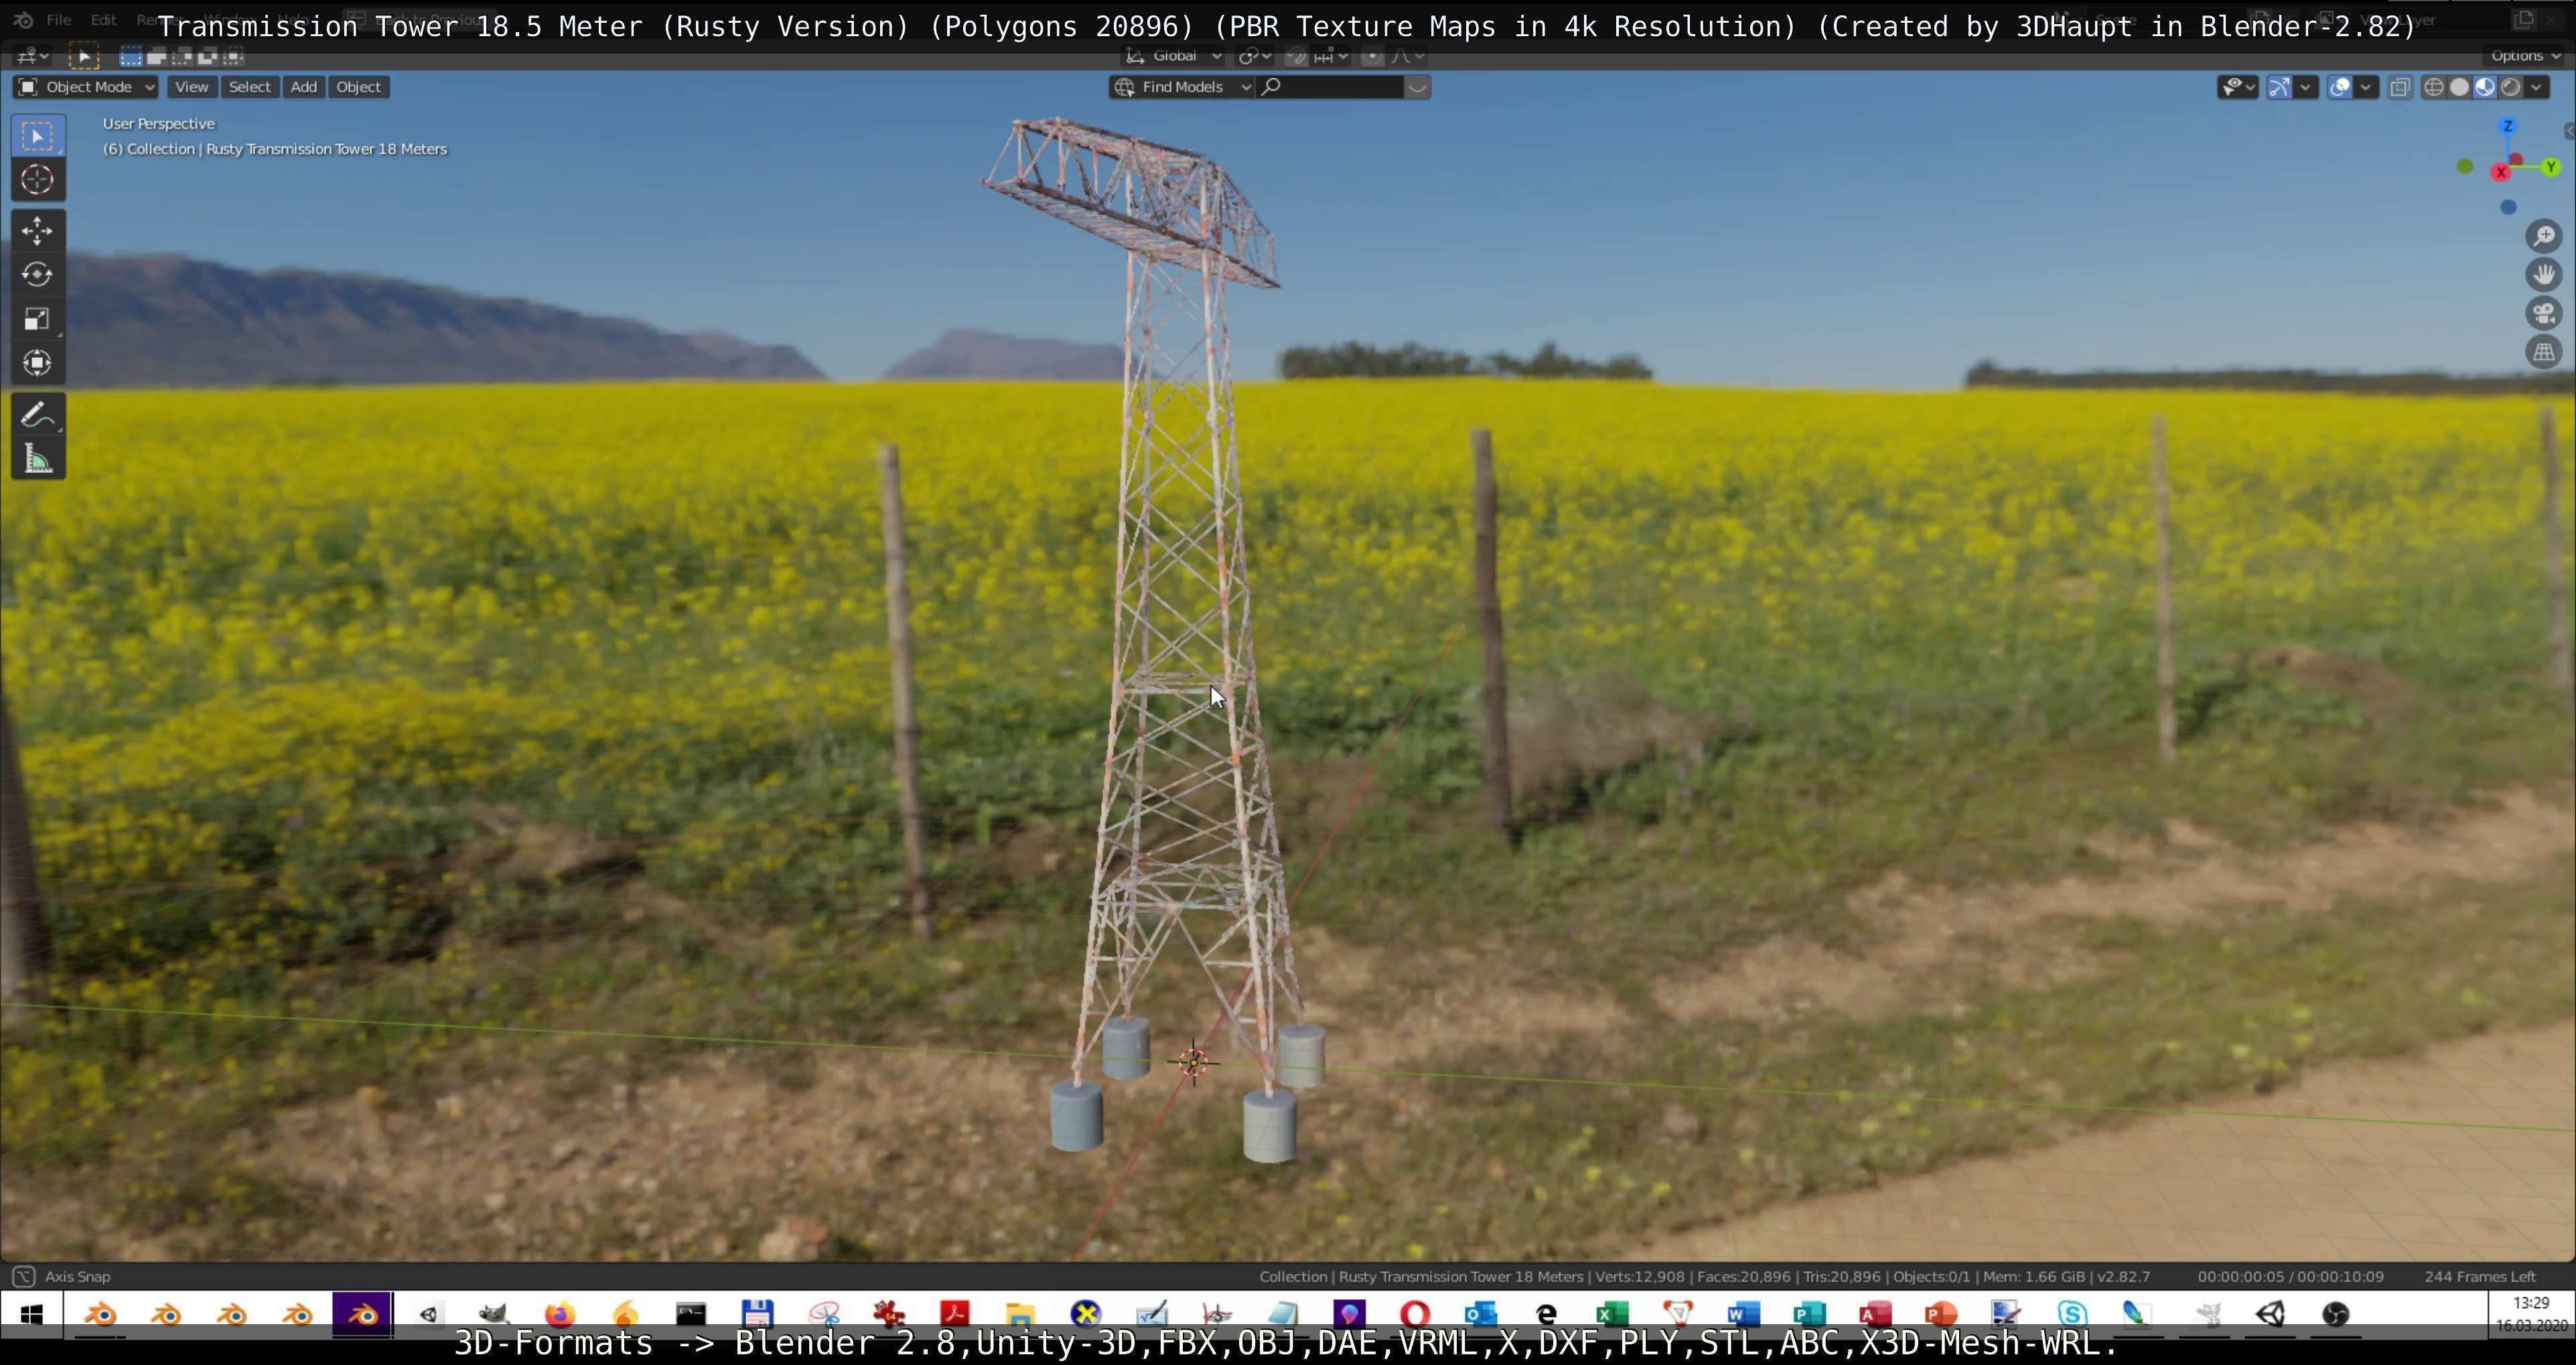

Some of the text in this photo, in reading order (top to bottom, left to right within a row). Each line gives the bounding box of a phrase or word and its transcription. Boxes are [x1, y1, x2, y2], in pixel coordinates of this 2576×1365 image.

[1154, 50, 1197, 62] Global
[2492, 49, 2545, 64] Options
[47, 81, 132, 95] Object Mode
[175, 81, 208, 92] View
[230, 81, 271, 92] Select
[291, 81, 317, 92] Add
[337, 81, 381, 95] Object
[1143, 80, 1223, 93] Find Models
[103, 118, 216, 133] User Perspective
[2504, 120, 2513, 132] Z
[103, 143, 123, 157] (6)
[128, 143, 196, 155] Collection
[207, 143, 243, 157] Rusty
[246, 143, 332, 155] Transmission
[335, 143, 375, 155] Tower
[379, 143, 396, 155] 18
[402, 143, 448, 155] Meters
[2496, 167, 2506, 177] X
[2547, 161, 2557, 172] Y
[45, 1271, 111, 1285] Axis Snap
[1260, 1271, 1328, 1283] Collection
[1340, 1271, 1378, 1285] Rusty
[1380, 1271, 1468, 1283] Transmission
[1470, 1271, 1512, 1283] Tower
[1516, 1271, 1533, 1283] 18
[1538, 1271, 1584, 1283] Meters
[1595, 1271, 1685, 1284] Verts:12,908
[1698, 1271, 1791, 1284] Faces:20,896
[1802, 1271, 1881, 1284] Tris:20,896
[1893, 1271, 1971, 1285] Objects:0/1
[1984, 1271, 2021, 1283] Mem:
[2026, 1271, 2057, 1283] 1.66
[2061, 1271, 2086, 1283] GiB
[2097, 1271, 2151, 1283] v2.82.7
[2198, 1271, 2285, 1283] 00:00:00:05
[2297, 1271, 2384, 1283] 00:00:10:09
[2425, 1271, 2537, 1283] 244 Frames Left
[2514, 1296, 2551, 1309] 13:29
[2496, 1319, 2569, 1332] 16.03.2020
